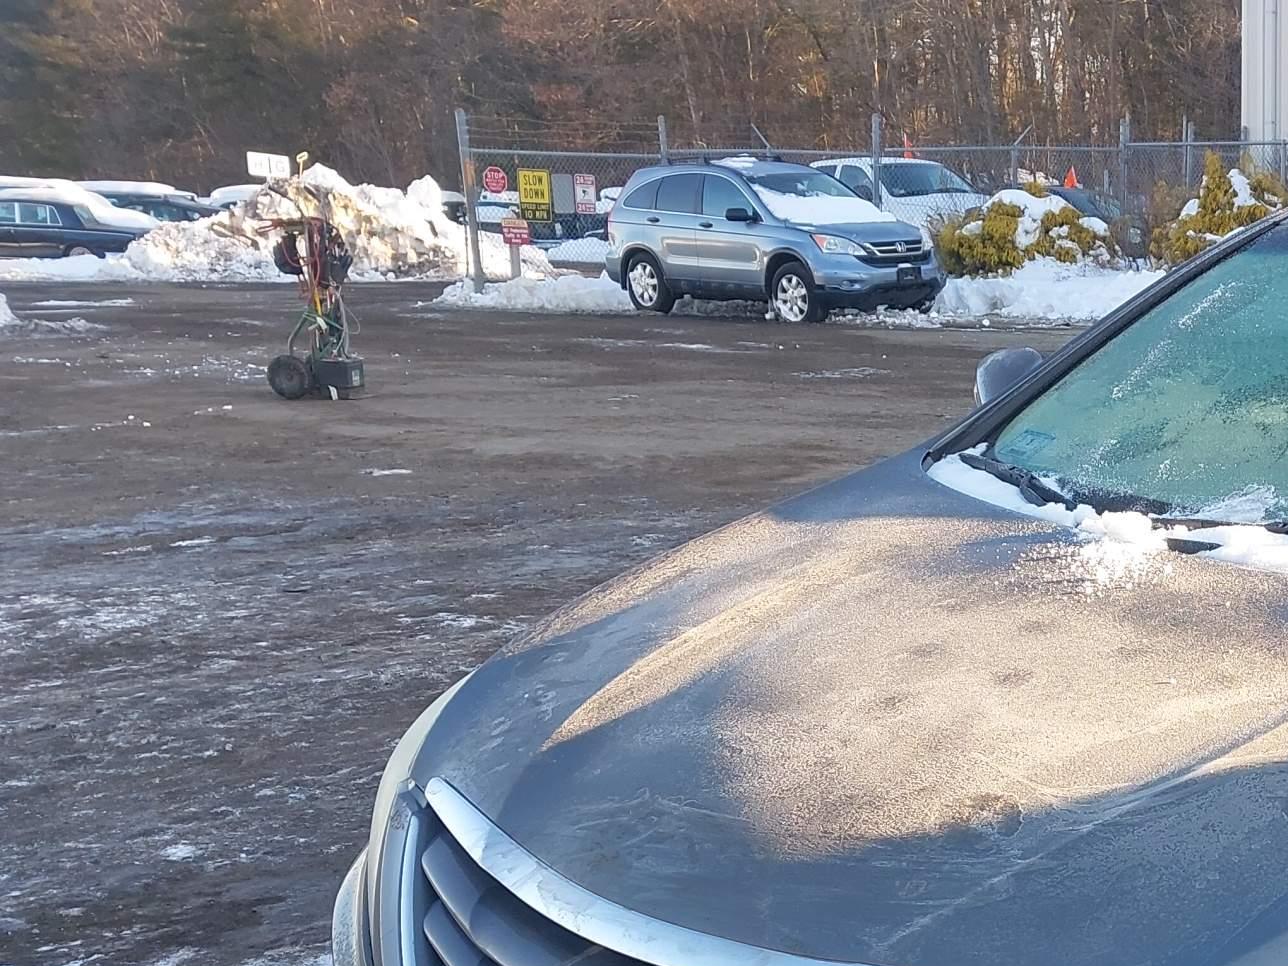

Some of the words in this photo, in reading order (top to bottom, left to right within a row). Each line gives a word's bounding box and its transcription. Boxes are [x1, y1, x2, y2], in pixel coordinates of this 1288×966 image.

[487, 171, 503, 179] STOP
[523, 174, 543, 186] SLOW
[523, 188, 545, 199] DOWN
[525, 210, 533, 218] 10
